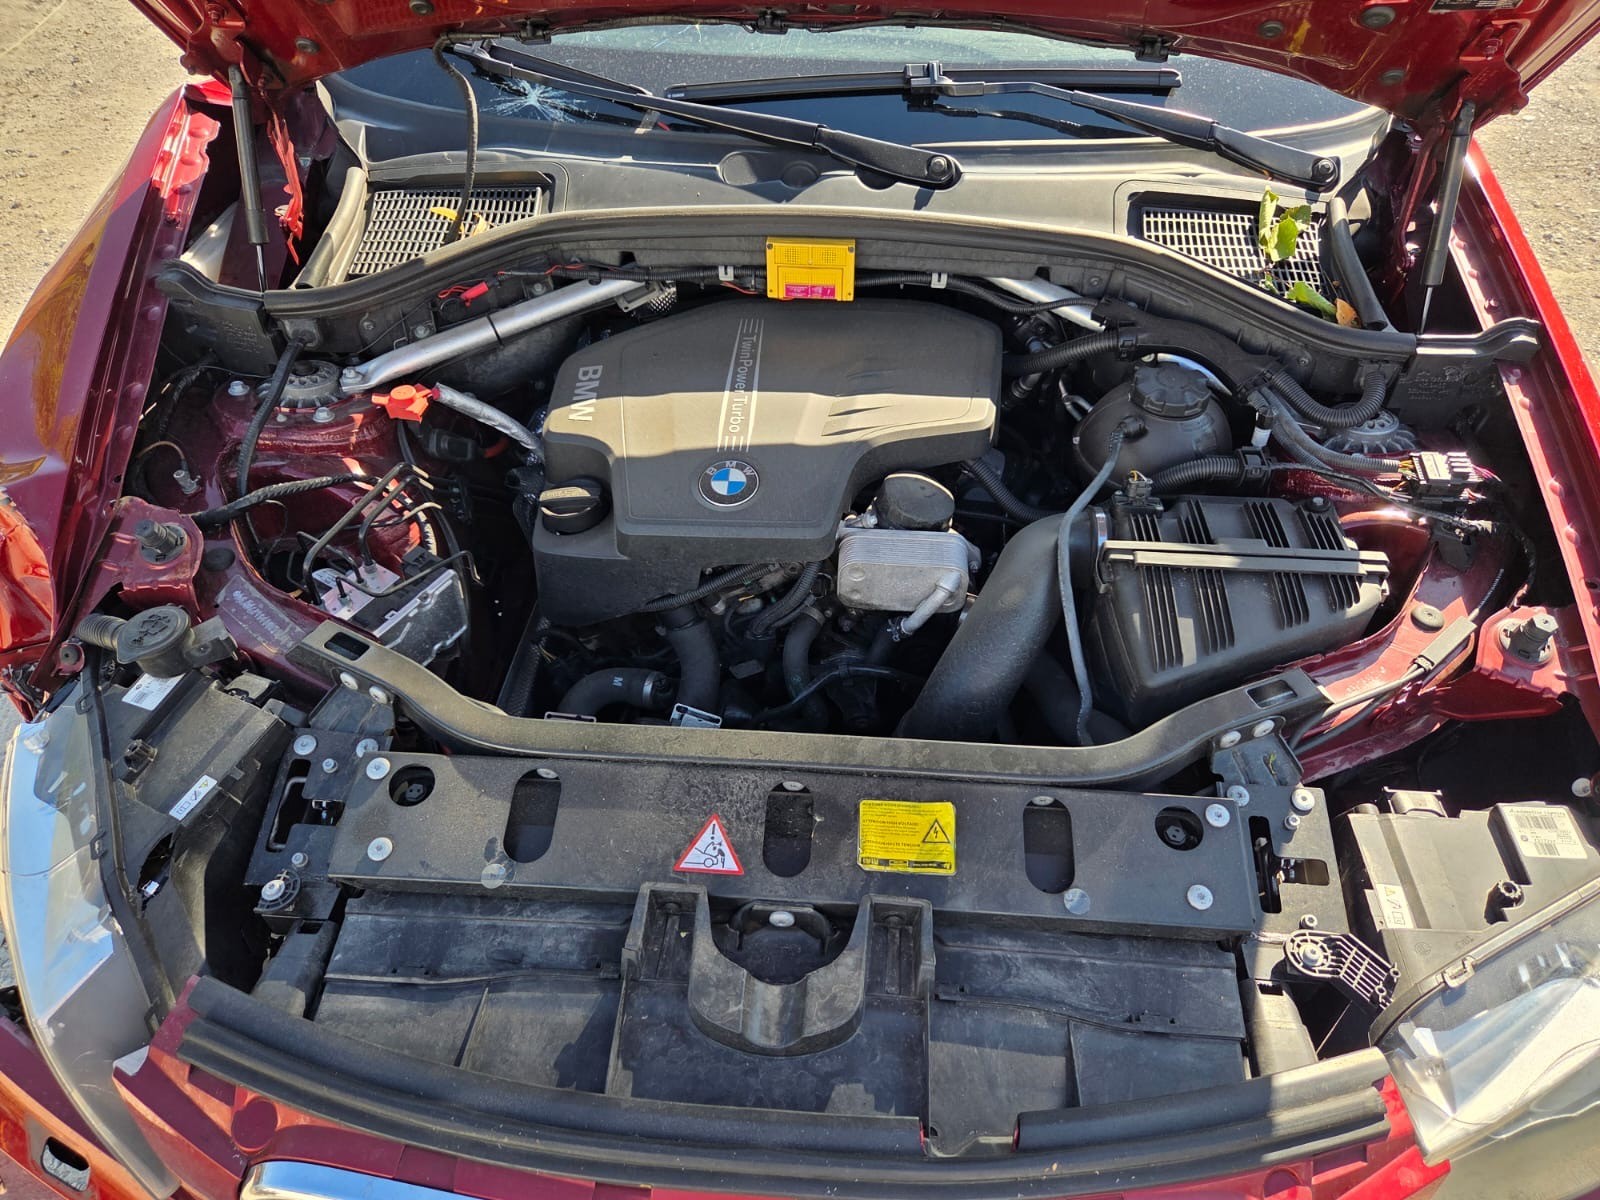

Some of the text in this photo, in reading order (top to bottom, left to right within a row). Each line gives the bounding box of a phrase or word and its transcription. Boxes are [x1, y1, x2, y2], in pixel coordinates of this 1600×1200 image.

[568, 365, 603, 421] BMW
[728, 394, 748, 433] Turbo
[706, 460, 755, 476] BMW
